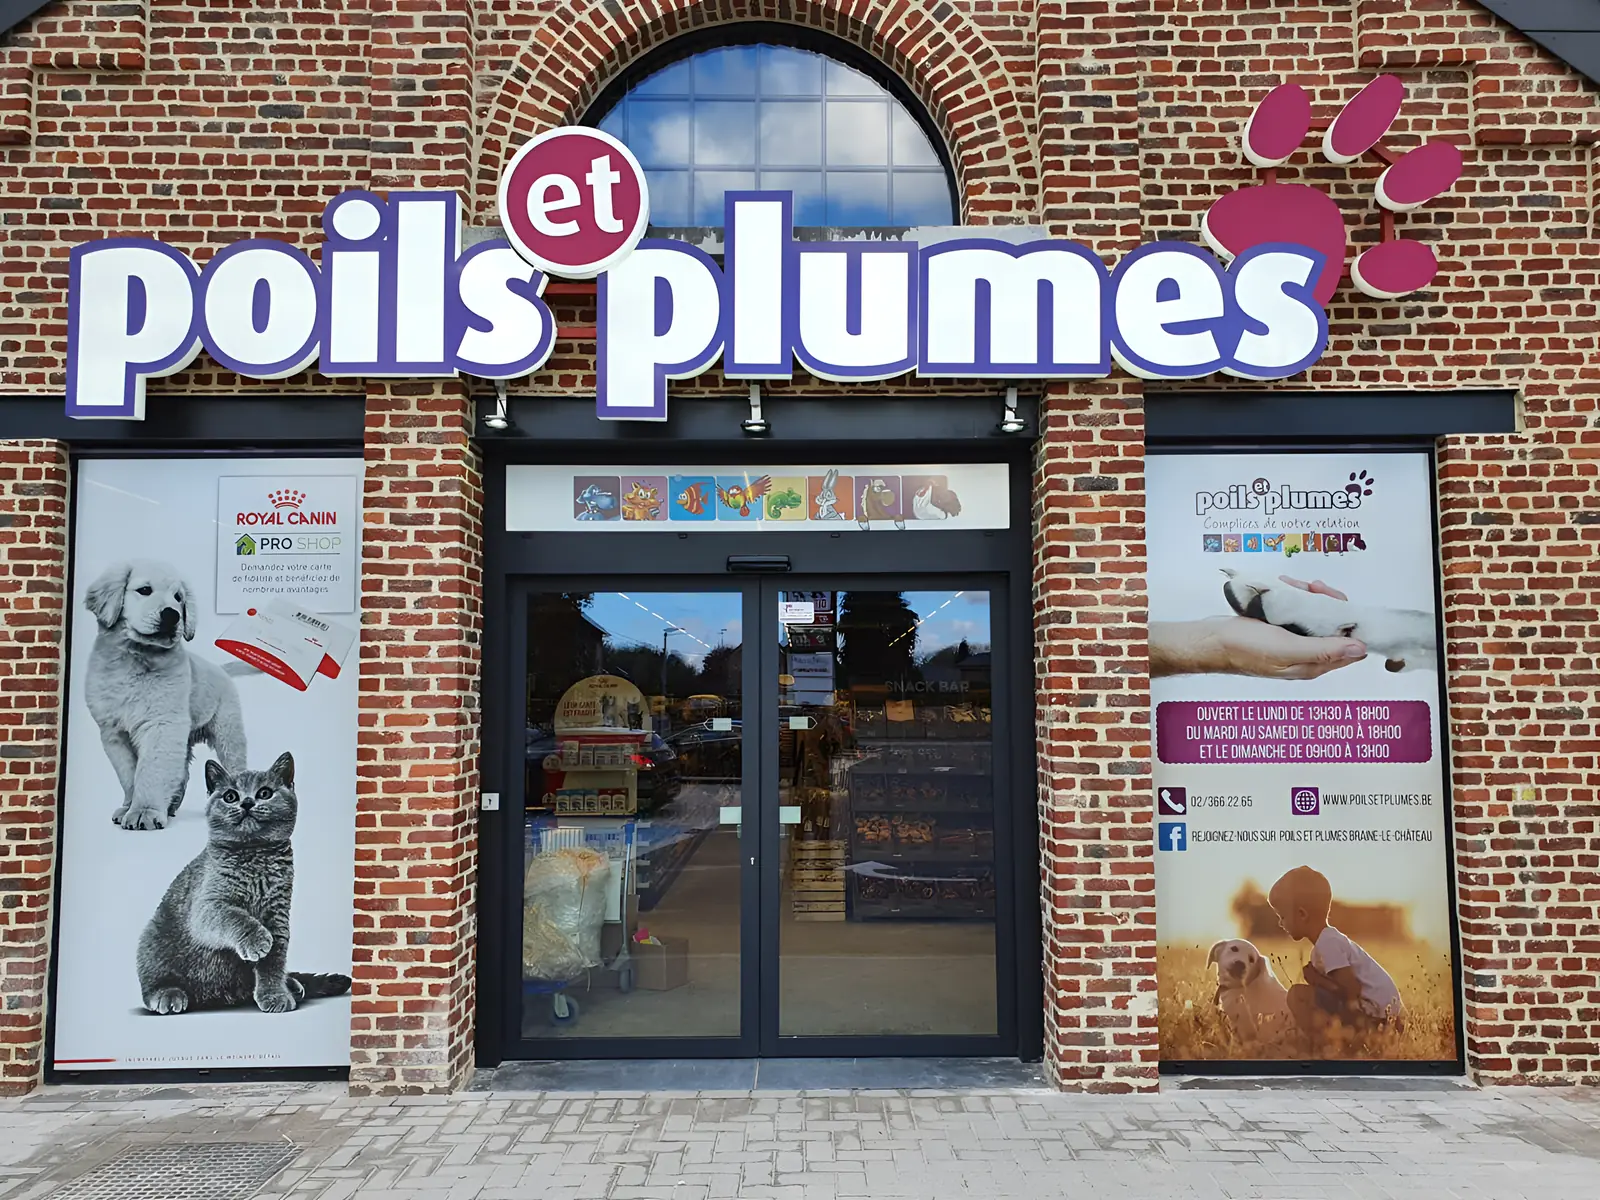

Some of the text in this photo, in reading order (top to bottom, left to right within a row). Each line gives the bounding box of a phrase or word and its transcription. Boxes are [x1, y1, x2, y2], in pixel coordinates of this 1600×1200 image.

[526, 154, 625, 238] et
[66, 190, 558, 420] poils
[596, 190, 1329, 422] plumes
[1253, 479, 1270, 493] et
[1196, 485, 1260, 515] poils
[1265, 485, 1361, 515] plumes
[236, 511, 337, 526] ROYAL CANIN
[1203, 517, 1360, 532] Complices de votre relation
[260, 536, 342, 550] PRO SHOP
[885, 680, 970, 693] SNACK BAR
[1197, 703, 1390, 721] OUVERT LE LUNDI DE 13H30 À 18H00
[1187, 721, 1401, 740] DU MARDI AU SAMEDI DE 09H00 À 18H00
[1200, 741, 1390, 759] ET LE DIMANCHE DE 09H00 À 13H00
[1322, 793, 1433, 806] WWW.POILSETPLUMES.BE
[1191, 830, 1259, 842] REJOIGNEZ-NOUS
[1303, 830, 1313, 842] ET
[1315, 830, 1348, 841] PLUMES
